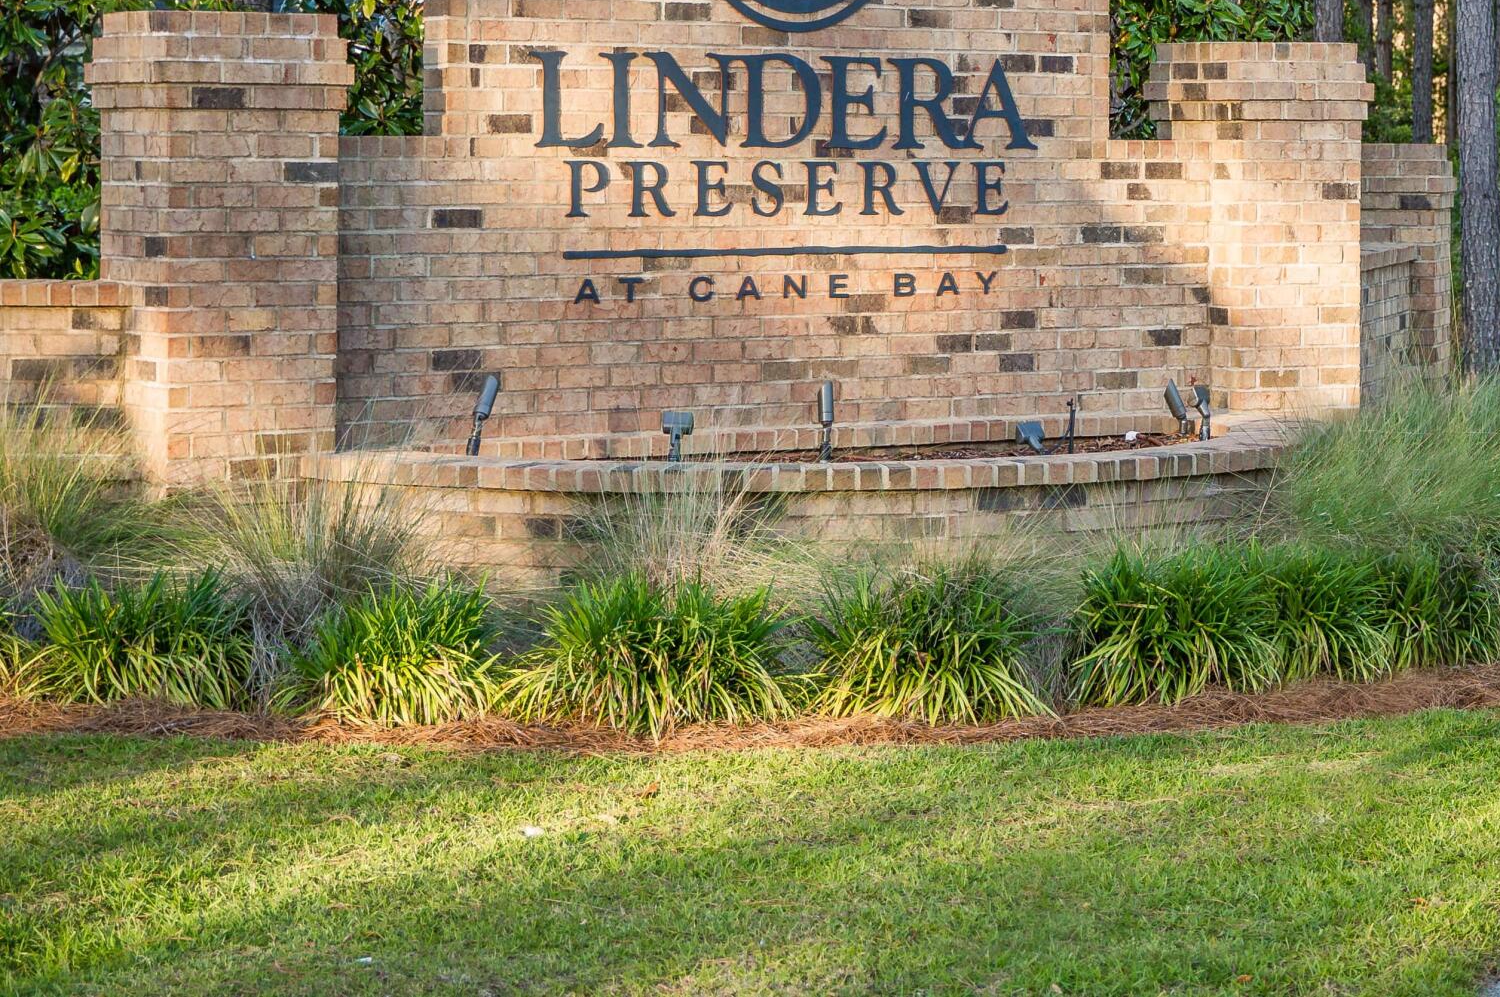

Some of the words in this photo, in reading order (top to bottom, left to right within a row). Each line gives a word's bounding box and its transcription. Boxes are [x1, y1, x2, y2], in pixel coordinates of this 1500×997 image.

[529, 50, 1038, 150] LINDERA
[563, 159, 1008, 218] PRESERVE
[573, 276, 645, 304] AT
[689, 273, 850, 302] CANE
[894, 270, 999, 298] BAY
